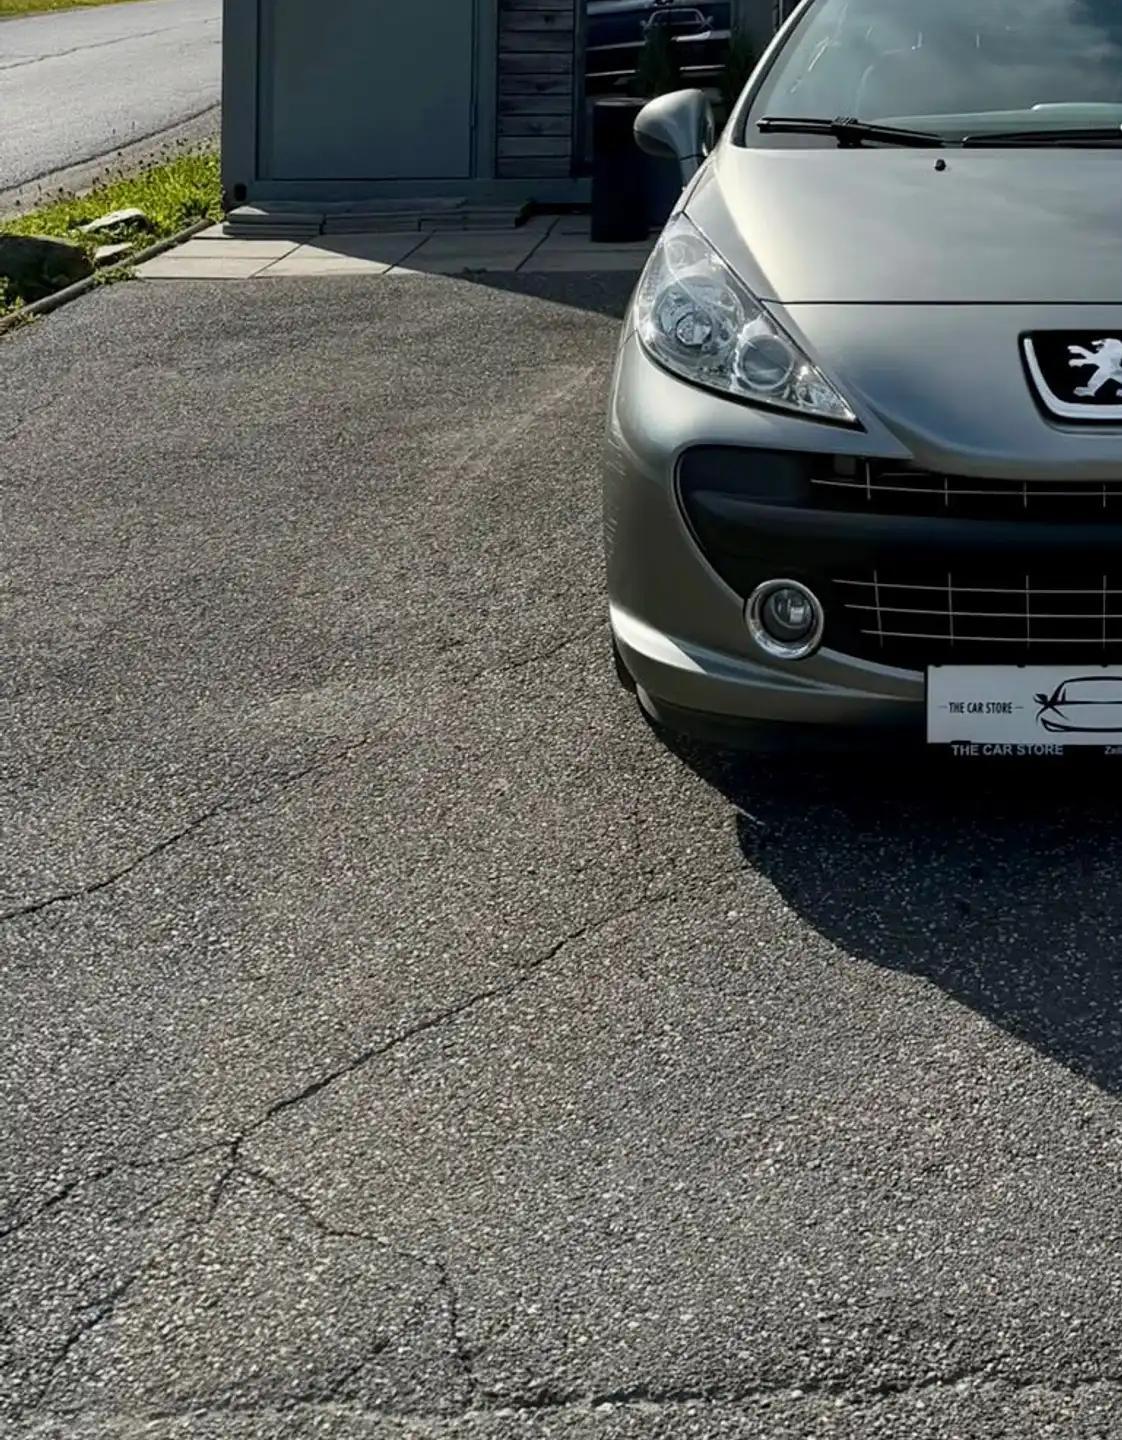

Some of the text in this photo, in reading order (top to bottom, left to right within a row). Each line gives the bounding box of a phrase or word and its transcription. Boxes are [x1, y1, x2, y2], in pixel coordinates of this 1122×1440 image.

[949, 702, 1013, 714] THE CAR STORE
[951, 744, 1063, 756] THE CAR STORE
